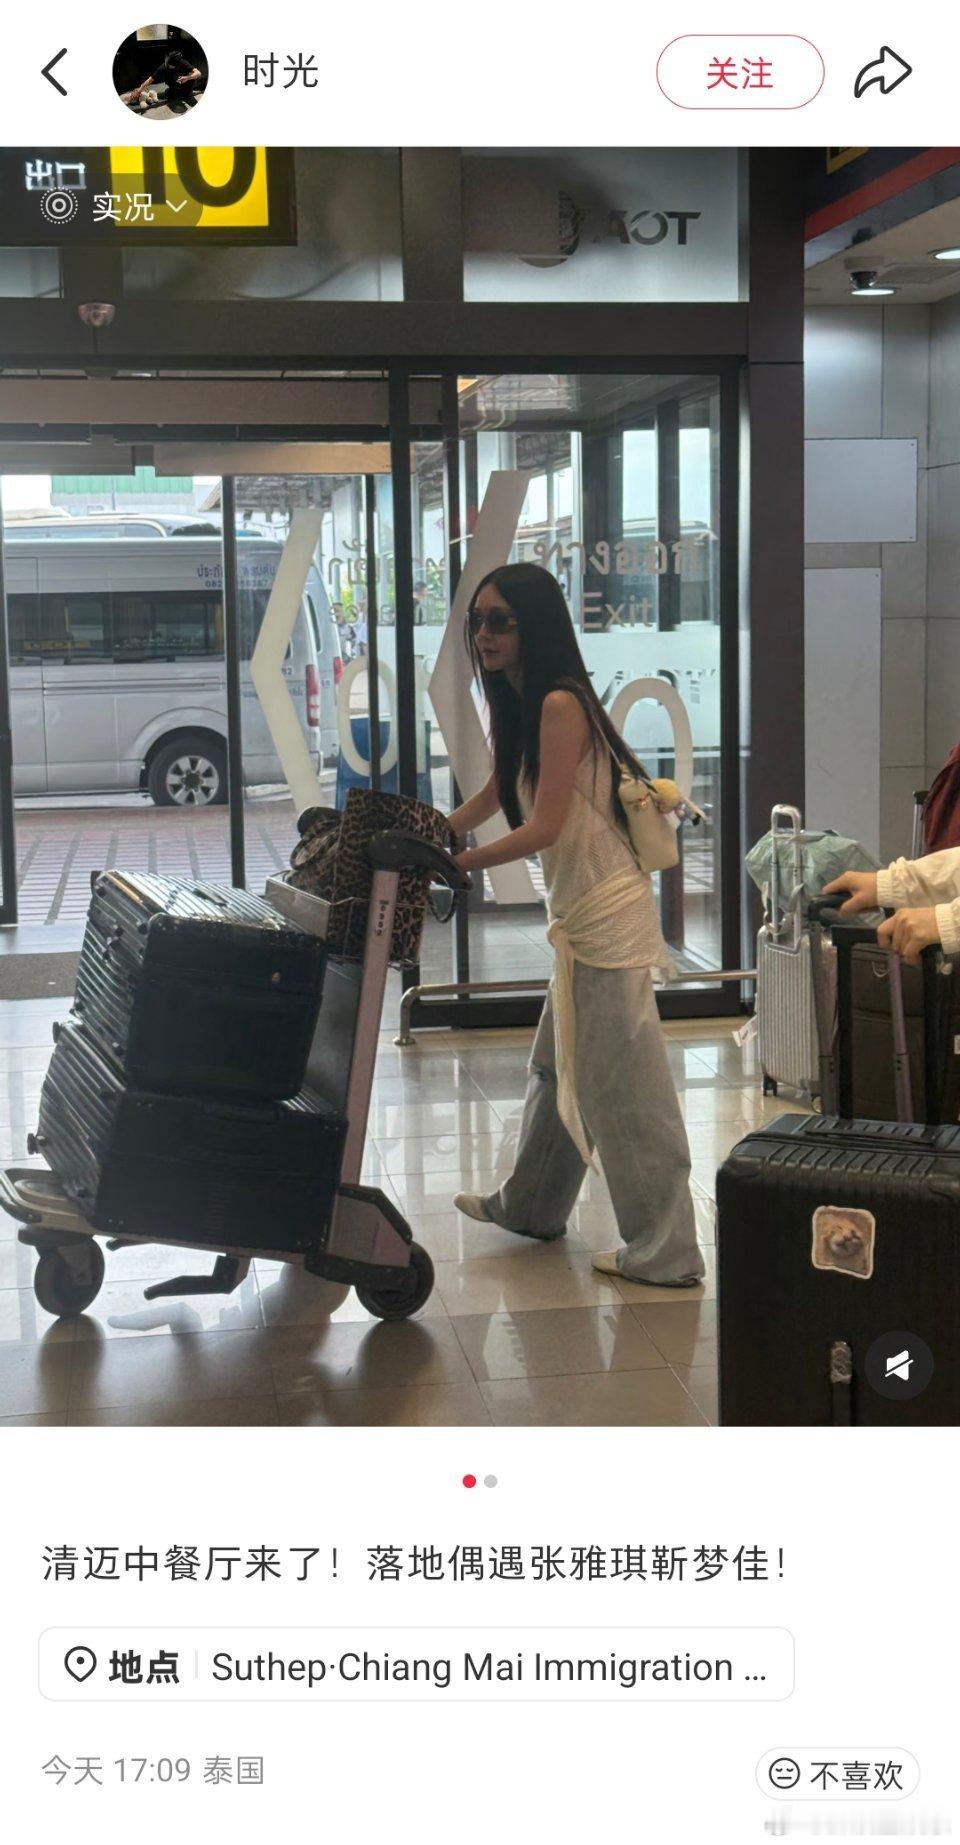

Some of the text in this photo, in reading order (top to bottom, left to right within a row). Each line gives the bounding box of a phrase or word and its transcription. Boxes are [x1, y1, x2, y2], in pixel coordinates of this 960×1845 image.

[25, 159, 87, 191] 出口
[592, 209, 702, 246] AOT
[580, 591, 653, 631] Exit
